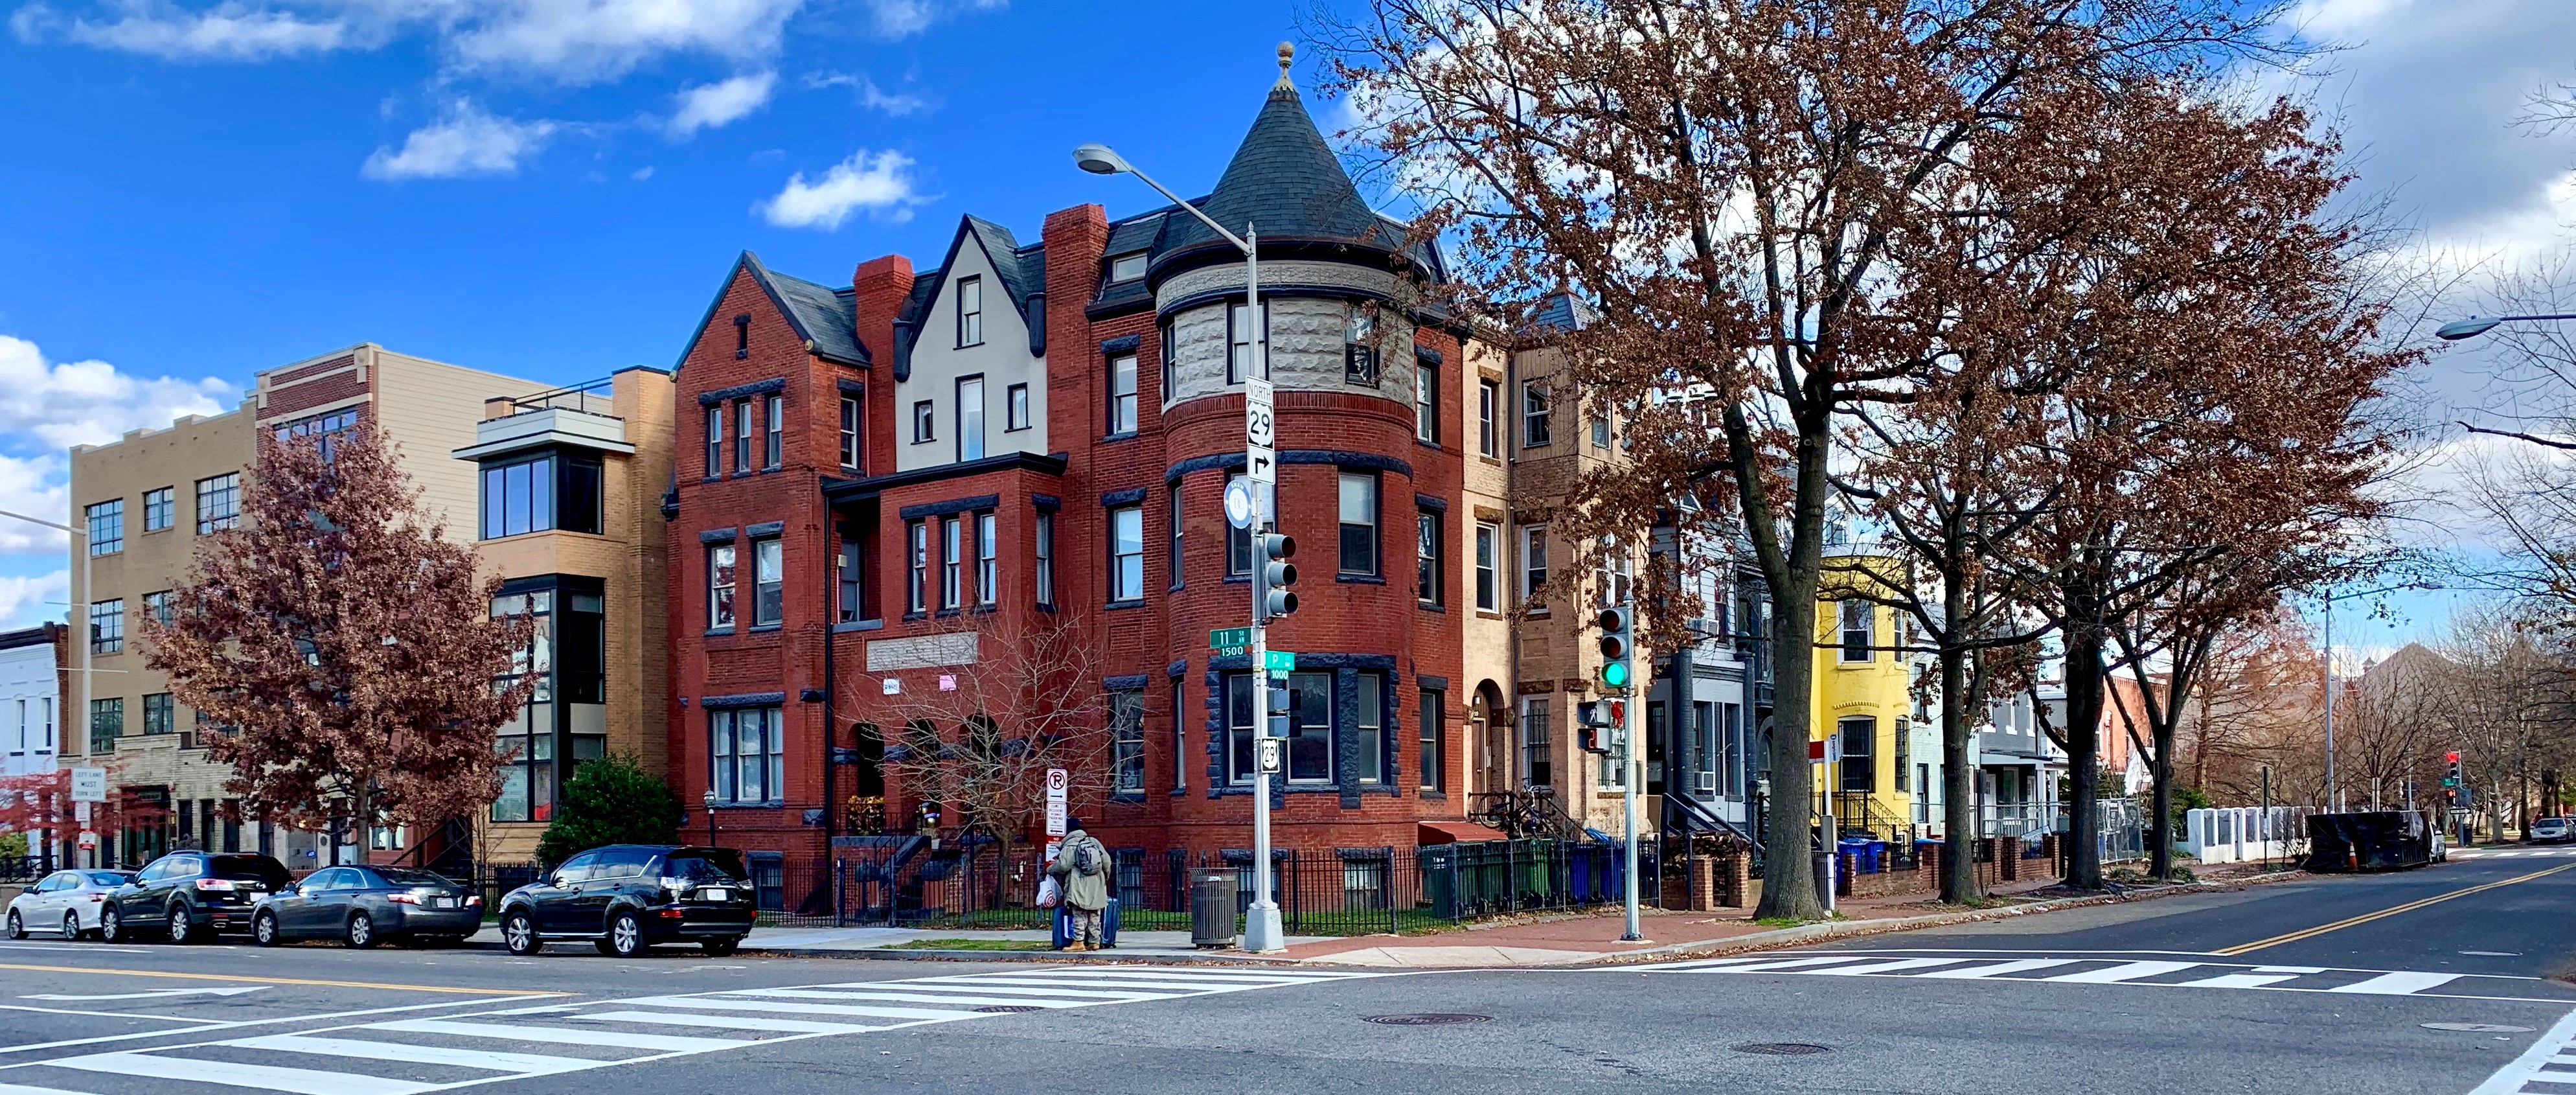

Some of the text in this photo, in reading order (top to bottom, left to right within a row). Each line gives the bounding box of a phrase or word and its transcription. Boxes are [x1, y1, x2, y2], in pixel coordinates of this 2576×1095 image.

[1249, 383, 1271, 400] NORTH
[1250, 410, 1270, 436] 29
[1220, 631, 1229, 645] 11
[1222, 646, 1244, 657] 1500
[1273, 654, 1279, 667] P
[1271, 669, 1289, 680] 1000
[1265, 746, 1275, 762] 29
